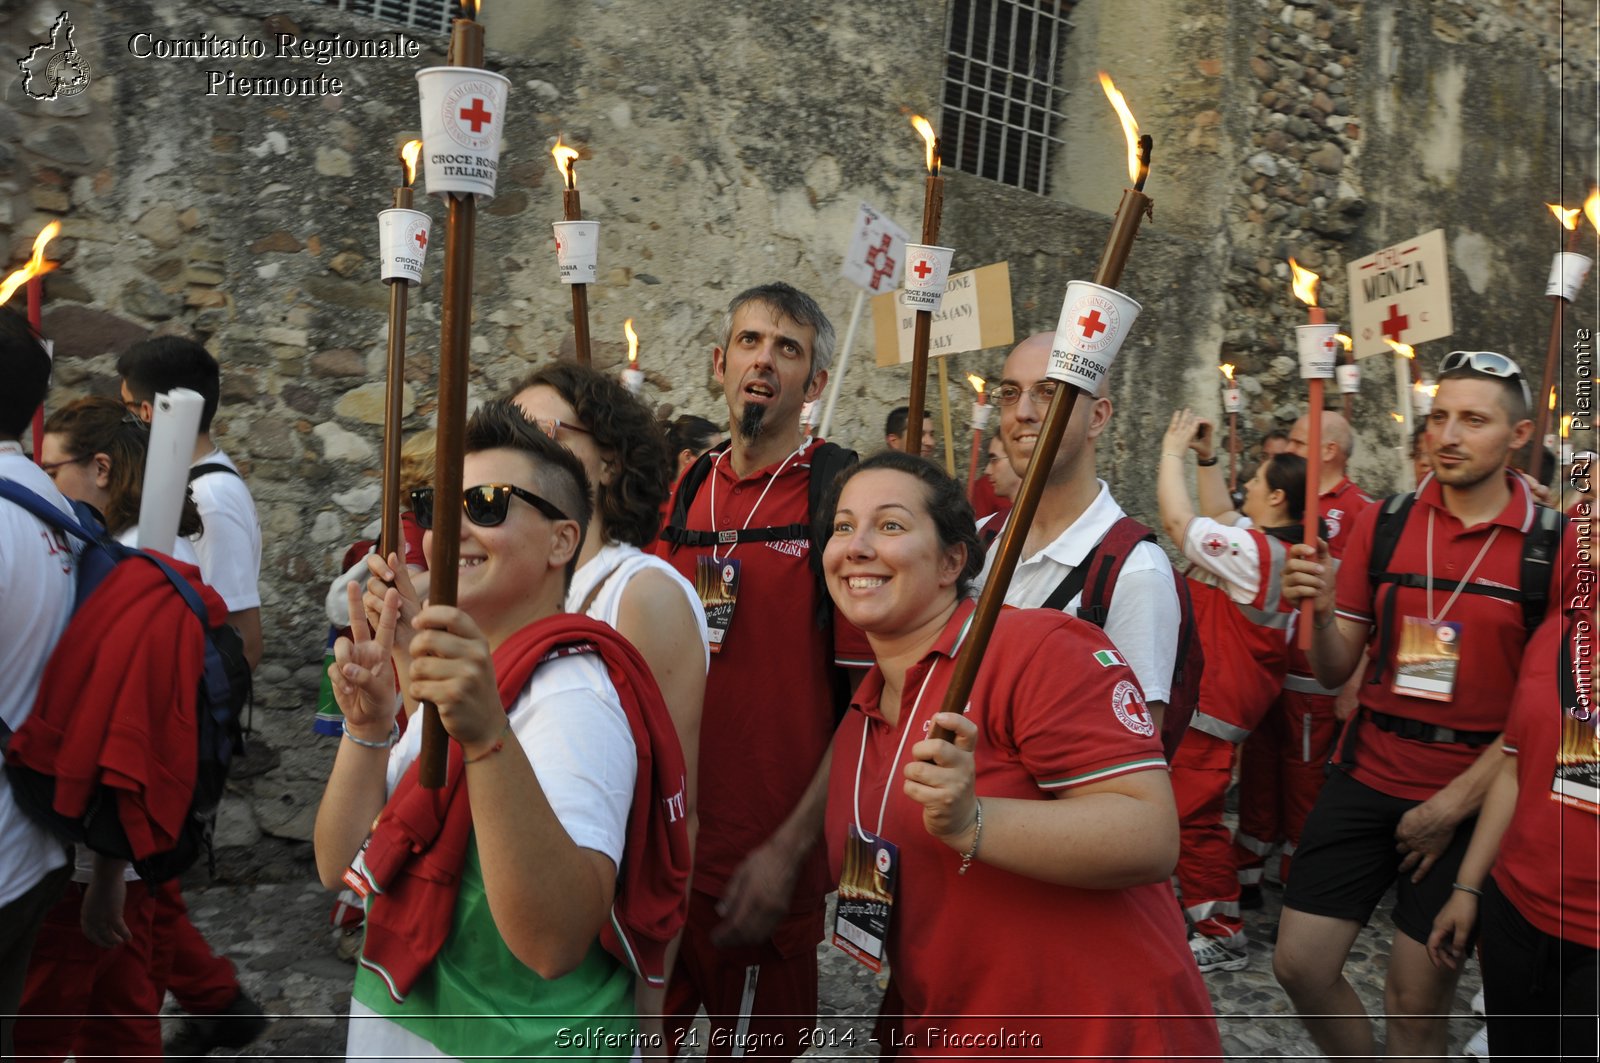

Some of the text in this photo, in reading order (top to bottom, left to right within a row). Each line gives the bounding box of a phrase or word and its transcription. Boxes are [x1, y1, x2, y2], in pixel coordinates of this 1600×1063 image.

[431, 154, 474, 166] CROCE
[1362, 260, 1428, 304] MONZA
[1052, 349, 1081, 363] CROCE
[1055, 359, 1097, 381] ITALIANA
